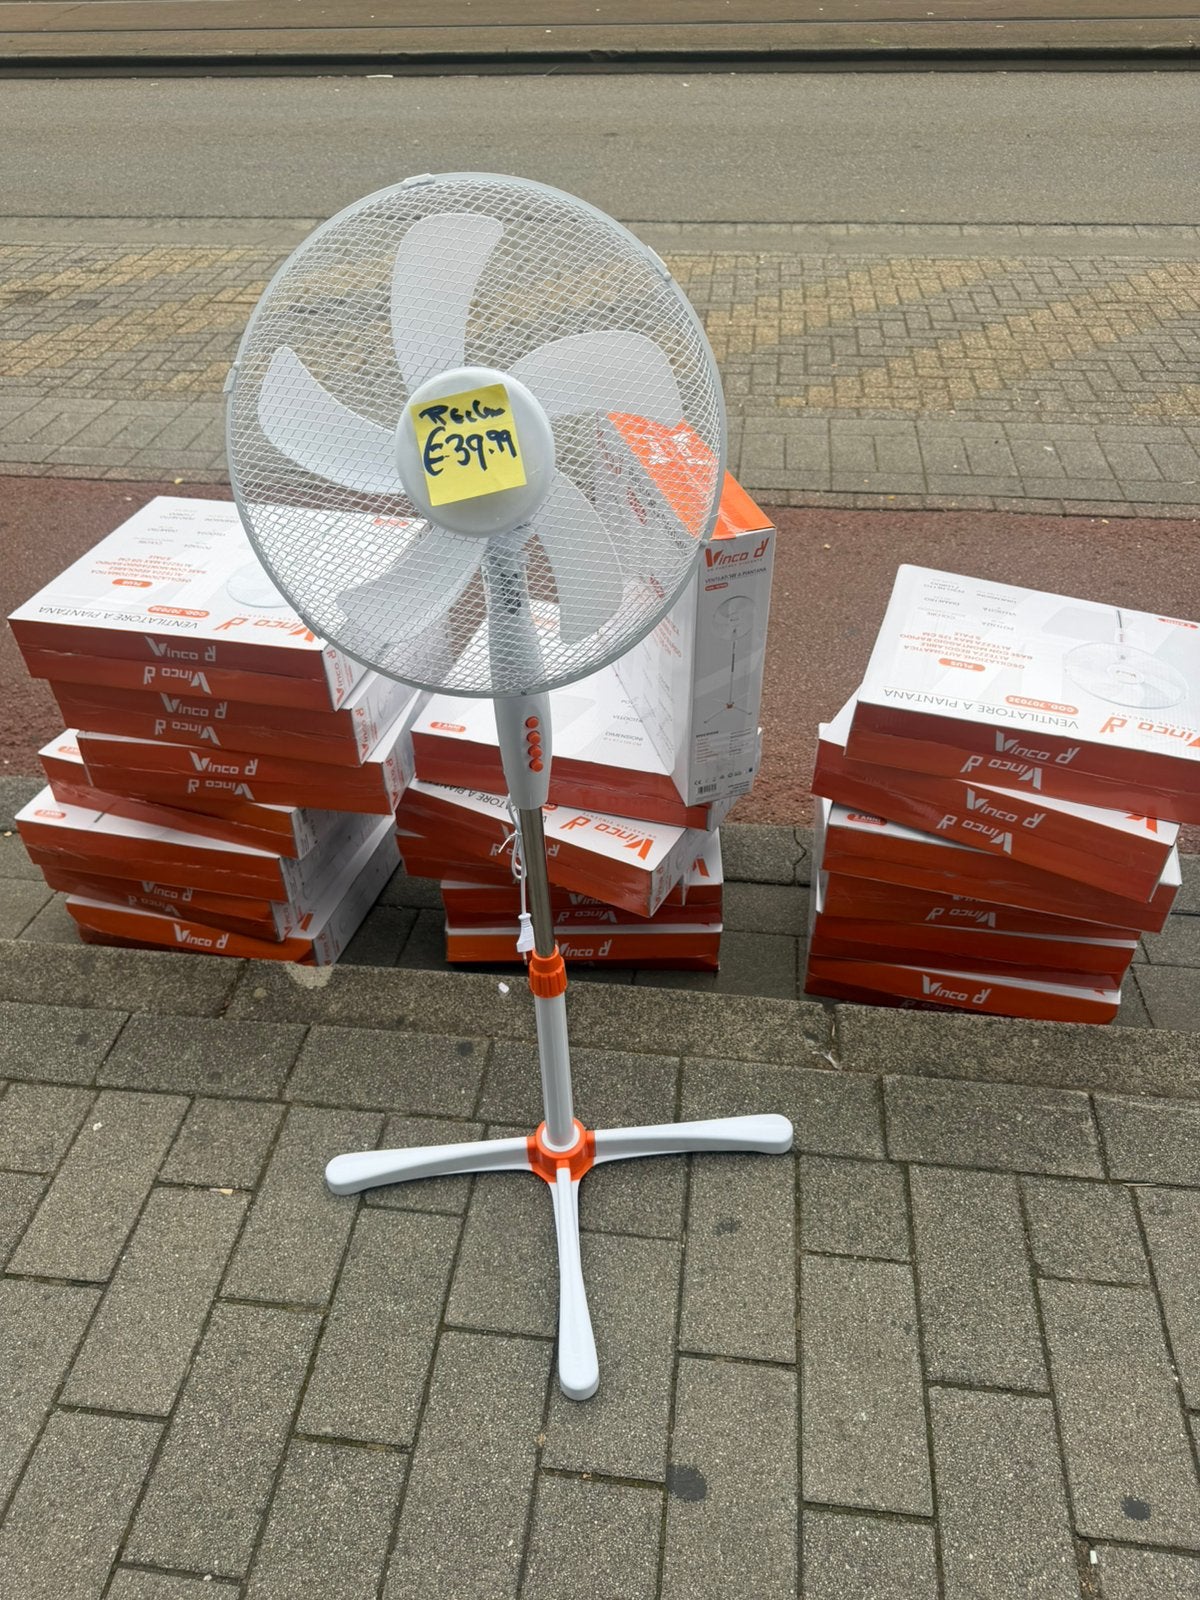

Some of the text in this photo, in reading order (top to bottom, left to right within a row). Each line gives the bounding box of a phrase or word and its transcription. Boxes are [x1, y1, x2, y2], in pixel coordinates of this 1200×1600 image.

[705, 548, 749, 568] Vinco
[38, 606, 101, 619] PIANTANA
[114, 614, 198, 630] VENTILATORE
[144, 635, 199, 660] Vinco
[951, 661, 973, 669] PLUS
[161, 668, 212, 694] Vinco
[160, 692, 209, 717] Vinco
[884, 689, 1079, 729] VENTILATORE A PIANTANA
[1047, 704, 1074, 713] COD.
[172, 721, 221, 746] Vinco
[996, 730, 1050, 760] Vinco
[189, 751, 239, 774] Vinco
[988, 759, 1042, 790] Vinco
[205, 780, 255, 801] Vinco
[967, 788, 1018, 822] Vinco
[594, 823, 654, 861] Vinco
[962, 820, 1012, 855] Vinco
[142, 880, 178, 899] Vinco
[575, 910, 617, 923] Vinco
[949, 908, 996, 928] Vinco
[173, 923, 213, 947] Vinco
[923, 974, 968, 1001] Vinco
